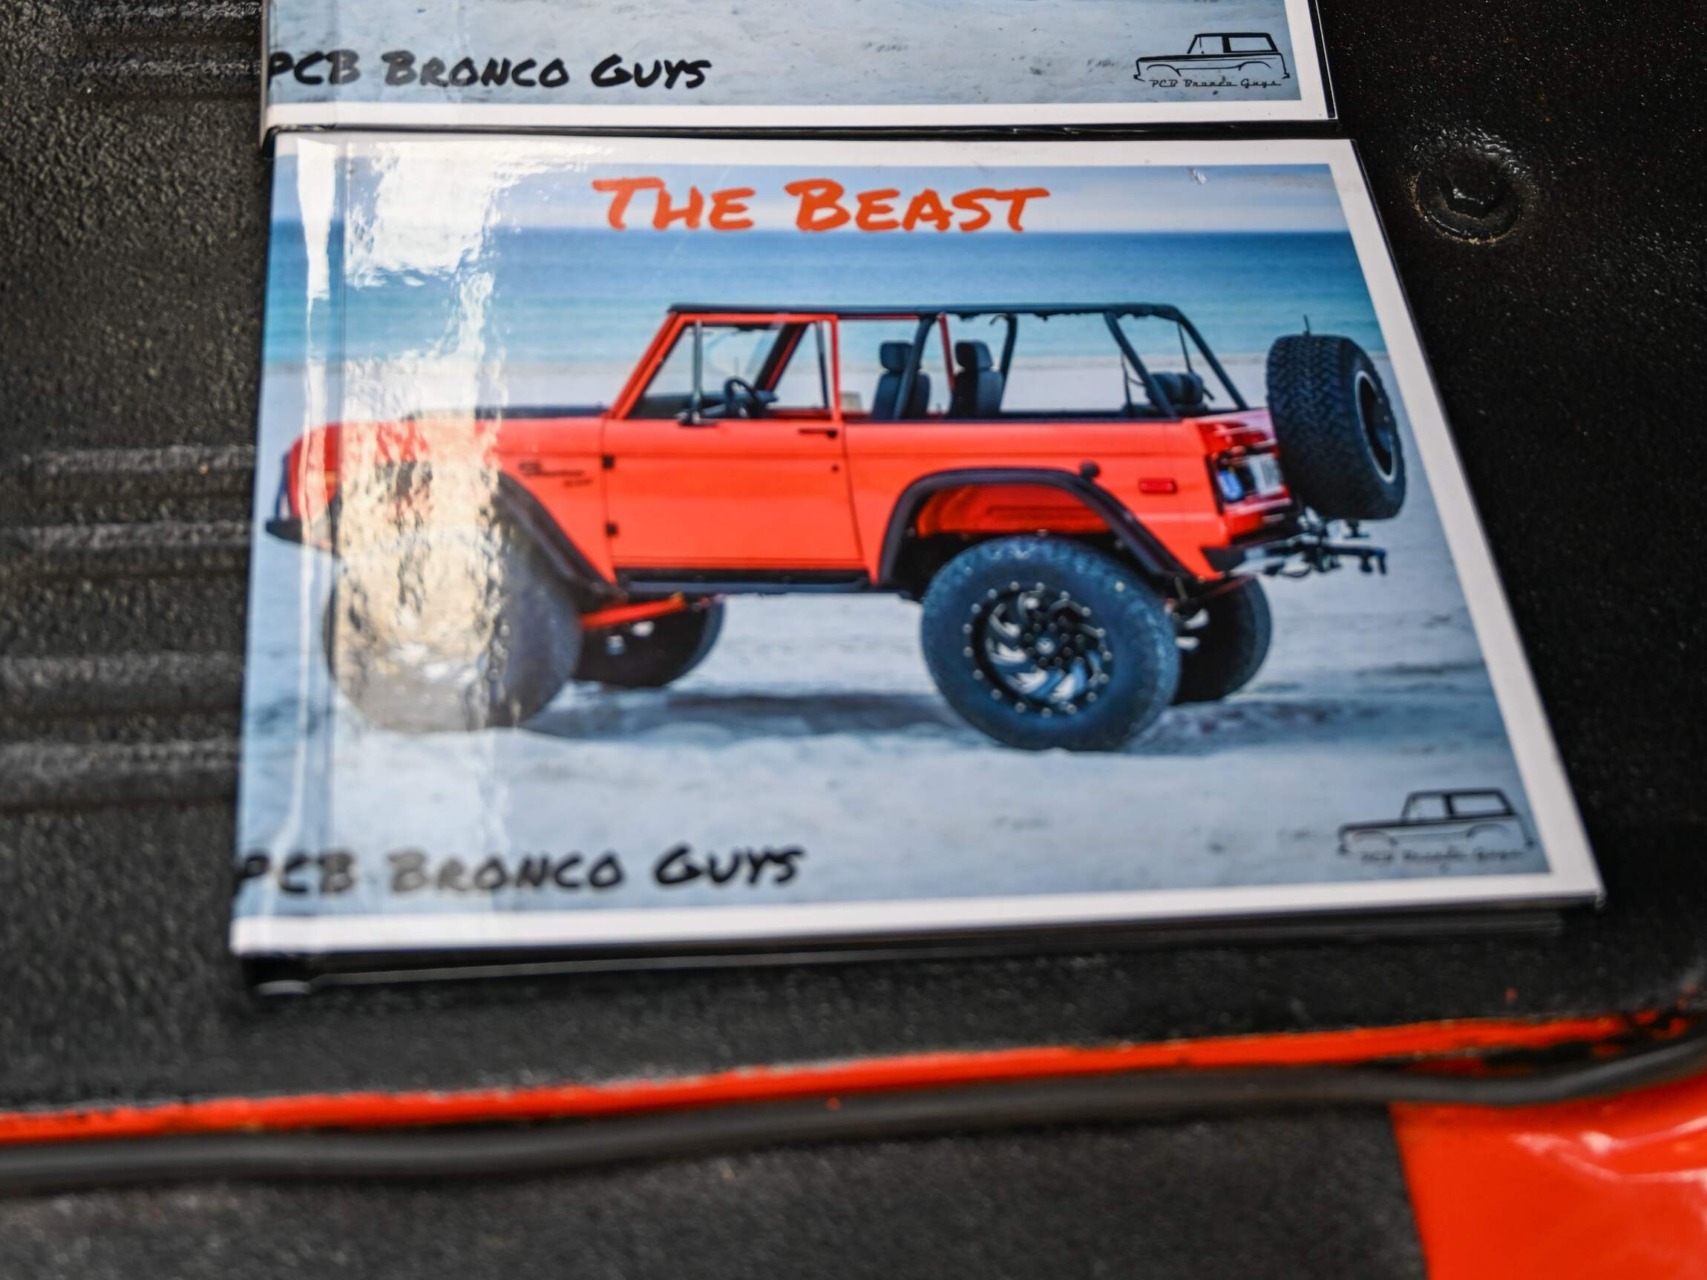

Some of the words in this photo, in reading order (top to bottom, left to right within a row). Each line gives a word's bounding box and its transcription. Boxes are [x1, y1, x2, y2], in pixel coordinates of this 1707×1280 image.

[267, 50, 362, 89] PCB
[381, 50, 570, 89] BRONCO
[590, 53, 713, 90] GUYS
[1150, 78, 1179, 89] PCB
[1182, 77, 1239, 89] Bronco
[1240, 77, 1283, 91] Guys
[592, 177, 756, 231] THE
[784, 178, 1051, 233] BEAST
[386, 850, 627, 894] BRONCO
[653, 844, 806, 889] GUYS
